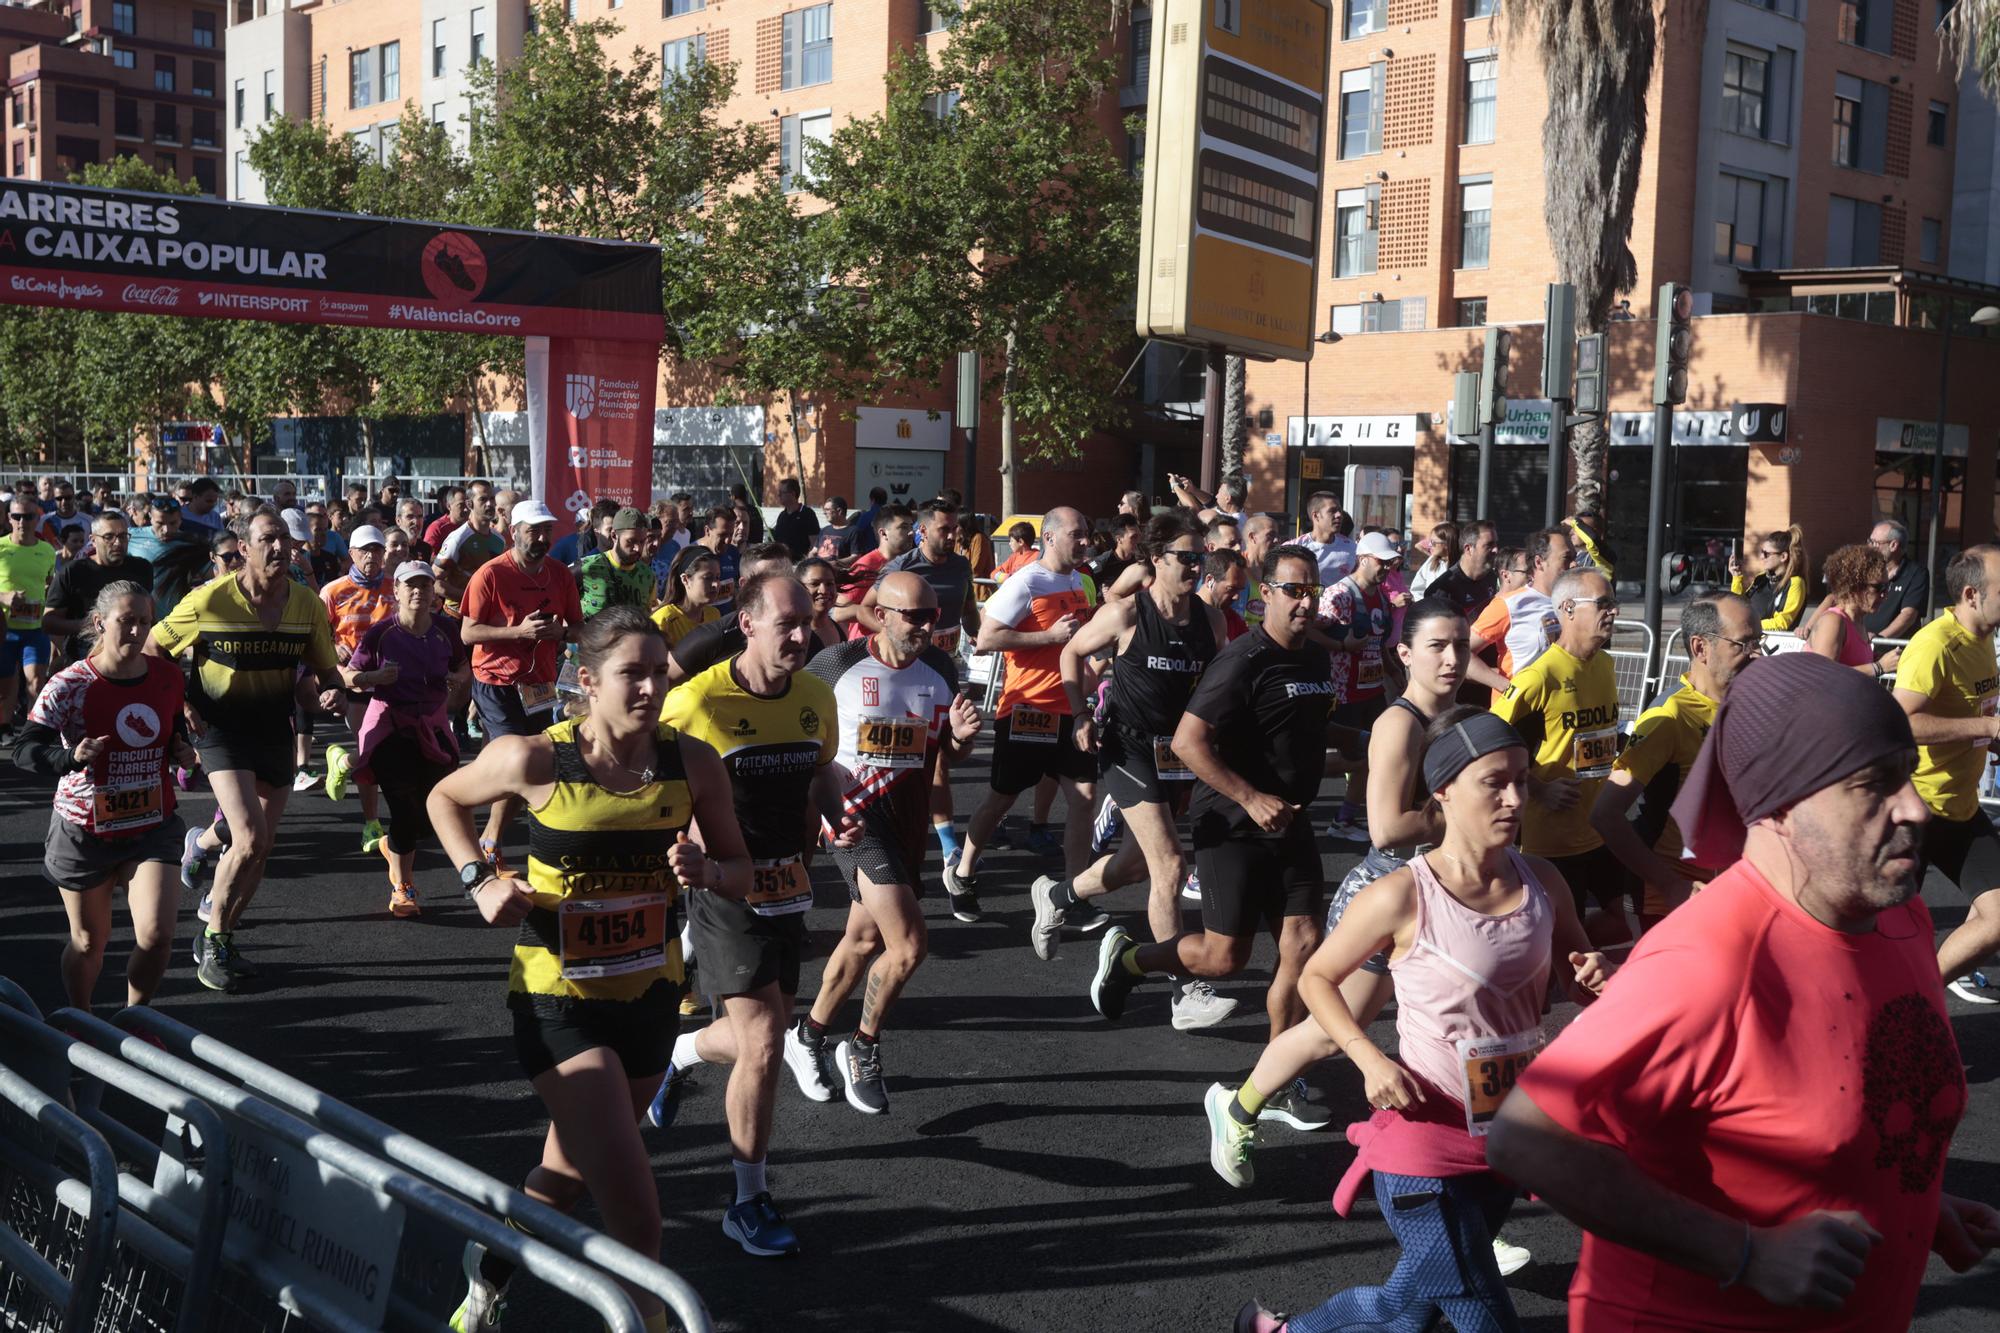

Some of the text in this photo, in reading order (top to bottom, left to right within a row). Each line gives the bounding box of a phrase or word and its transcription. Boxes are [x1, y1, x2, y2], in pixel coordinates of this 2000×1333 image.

[25, 227, 153, 266] CAIXA
[157, 240, 327, 280] POPULAR
[213, 293, 310, 313] INTERSPORT
[330, 301, 369, 312] aspaym
[388, 304, 521, 328] #ValènciaCorre
[599, 379, 640, 389] Fundació
[598, 389, 640, 399] Esportiva
[598, 400, 641, 411] Municipal
[1496, 422, 1549, 439] unning
[590, 447, 617, 457] caixa
[590, 457, 633, 468] popular
[1018, 711, 1052, 729] 3442
[1562, 702, 1619, 731] REDOLA
[867, 726, 914, 747] 4019
[108, 748, 155, 762] CIRCUIT
[735, 754, 780, 769] PATERNA
[105, 787, 149, 812] 3421
[578, 909, 647, 945] 4154
[301, 1226, 379, 1303] RUNNING
